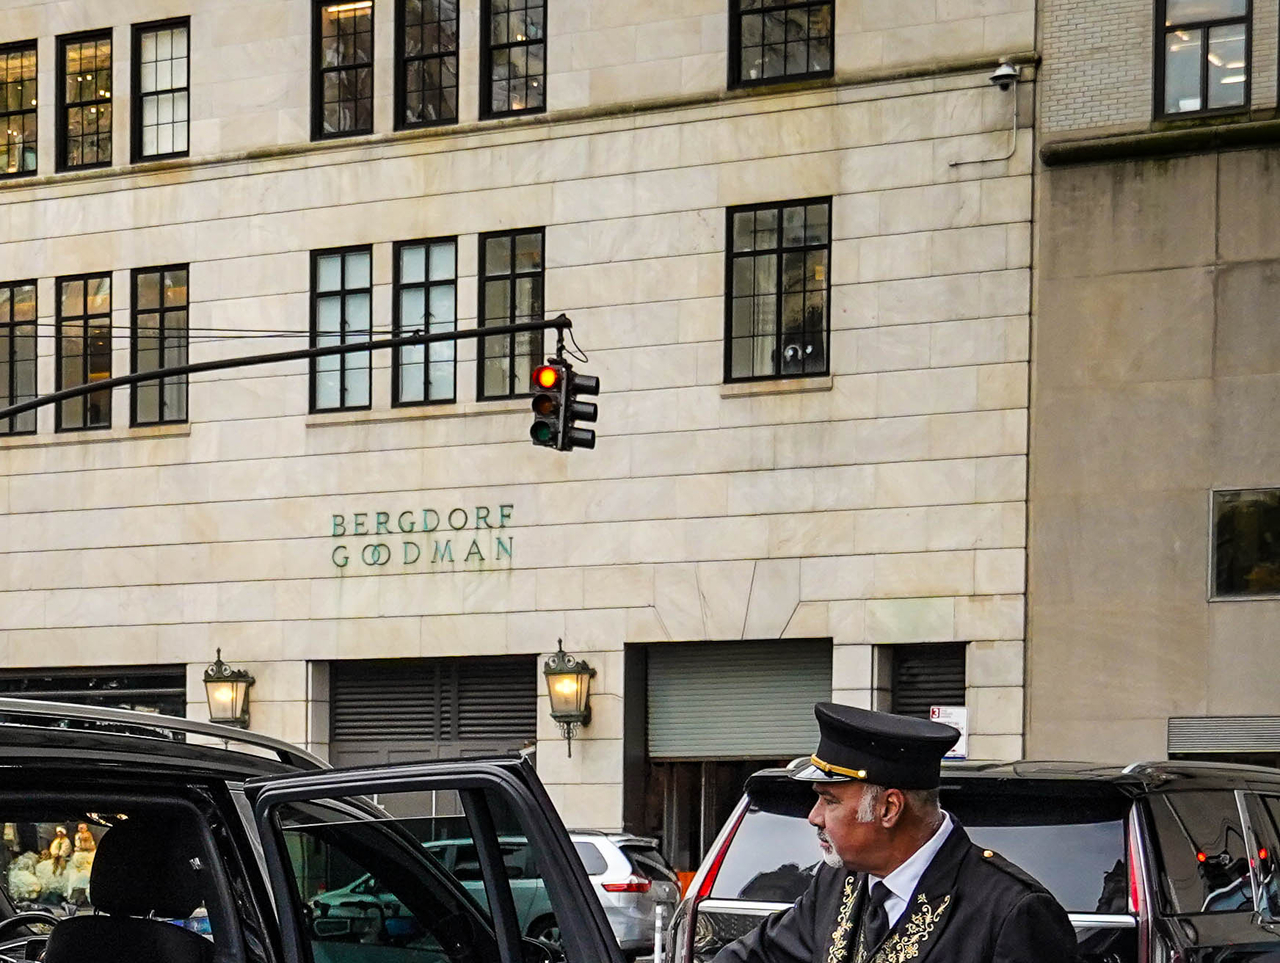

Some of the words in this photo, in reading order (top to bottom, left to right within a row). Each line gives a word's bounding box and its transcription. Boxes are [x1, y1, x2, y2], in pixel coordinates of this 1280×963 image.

[332, 504, 514, 537] BERGDORF
[332, 536, 514, 568] GOODMAN
[932, 708, 939, 718] 3
